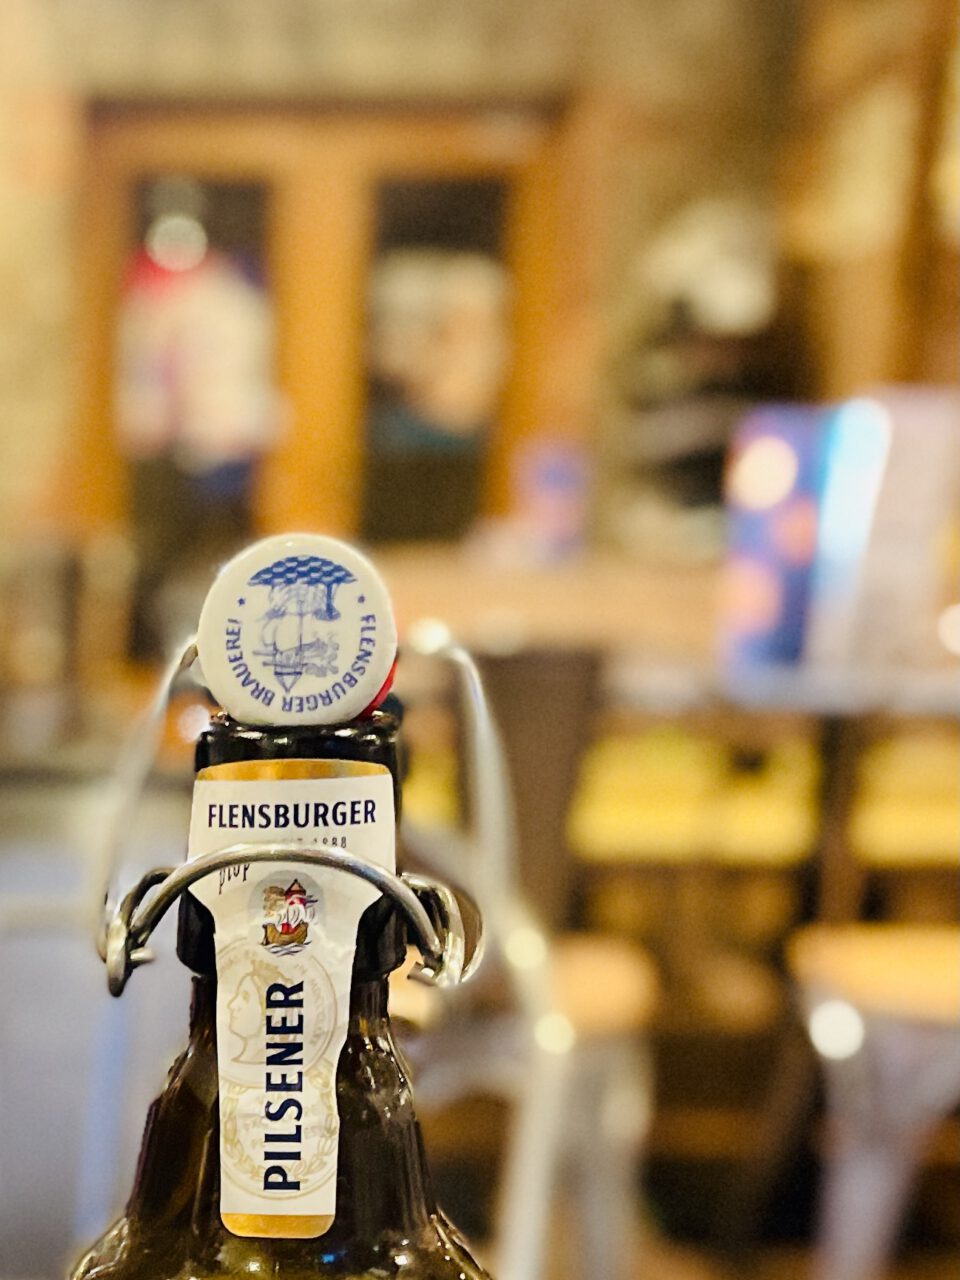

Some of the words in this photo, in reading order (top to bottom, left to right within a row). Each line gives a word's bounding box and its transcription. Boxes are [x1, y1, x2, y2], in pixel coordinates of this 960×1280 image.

[225, 618, 276, 707] BRAUEREI
[281, 614, 376, 713] FLENSBURGER
[207, 799, 376, 829] FLENSBURGER
[263, 980, 304, 1191] PILSENER
